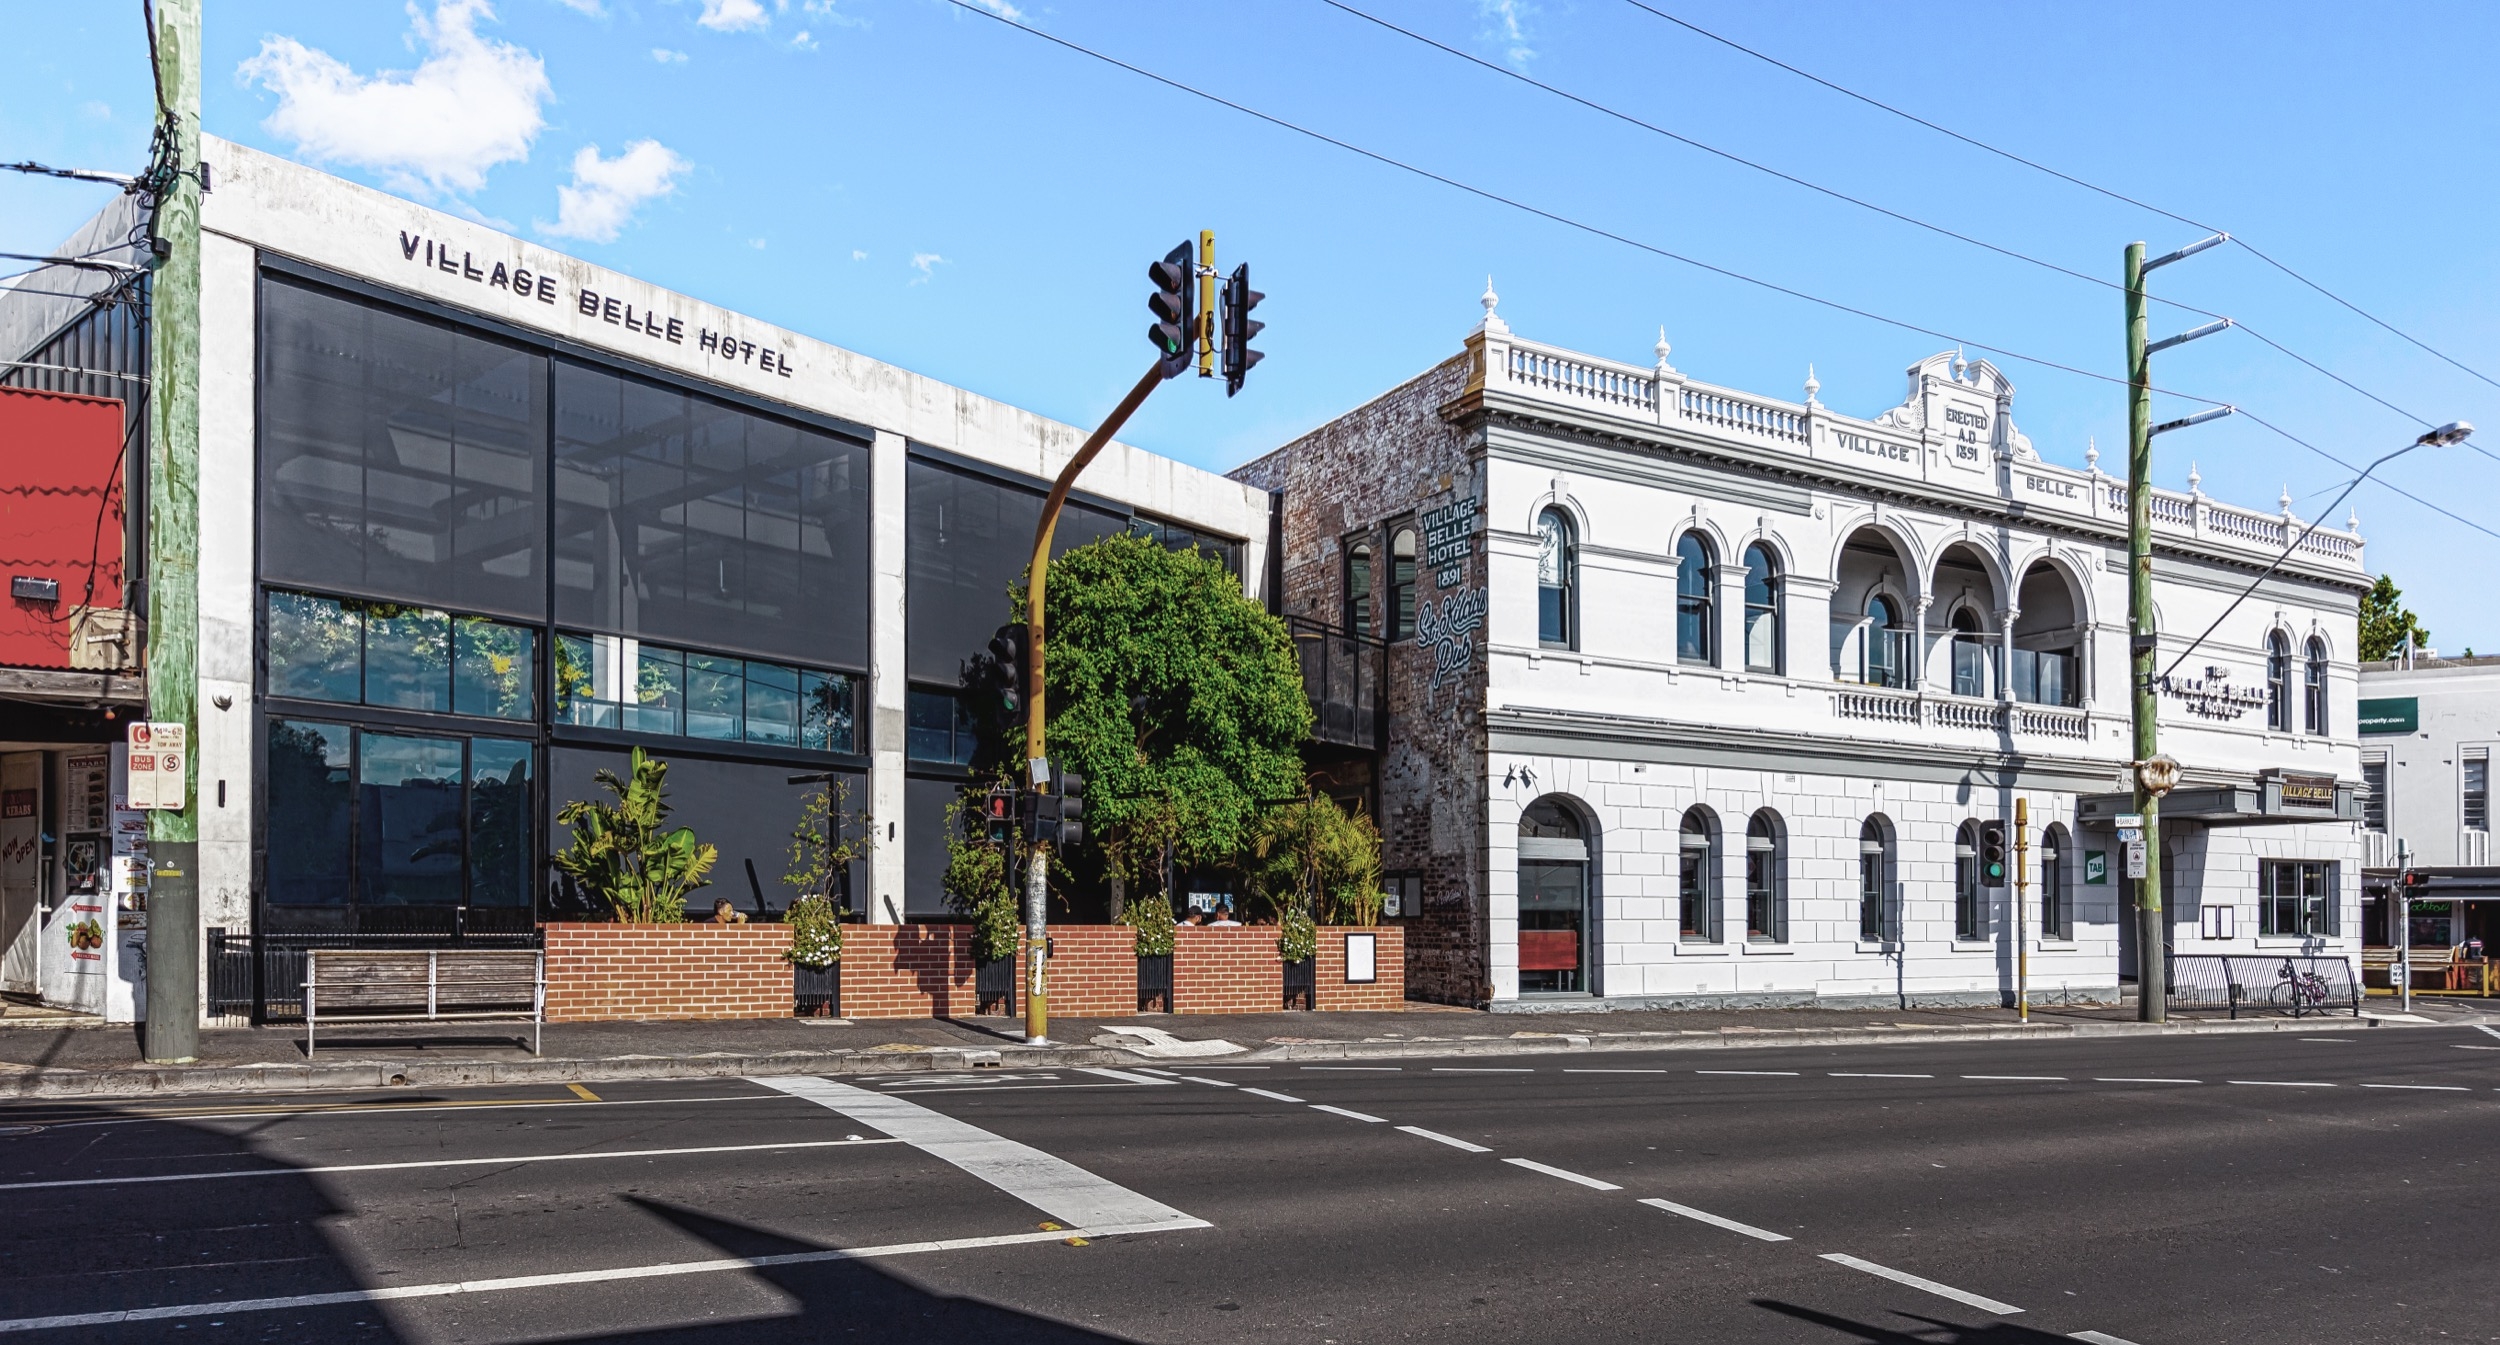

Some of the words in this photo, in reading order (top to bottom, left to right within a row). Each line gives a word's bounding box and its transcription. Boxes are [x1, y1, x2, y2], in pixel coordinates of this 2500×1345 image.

[400, 230, 557, 302] VILLAGE
[579, 288, 684, 342] BELLE
[700, 328, 793, 376] HOTEL
[1946, 407, 1987, 430] ERECTED
[1956, 444, 1978, 461] 1891
[1423, 499, 1475, 531] VILLAGE
[1428, 519, 1471, 547] BELLE
[1428, 542, 1471, 566] HOTEL
[1438, 570, 1461, 588] 1891
[1434, 635, 1472, 689] Pub
[69, 760, 104, 768] KEBABS
[2281, 785, 2313, 798] VILLAGE
[2313, 788, 2332, 799] BELLE
[6, 804, 32, 817] KEBABS
[2, 835, 18, 862] NOW
[15, 836, 35, 864] OPEN
[2089, 863, 2103, 872] TAB
